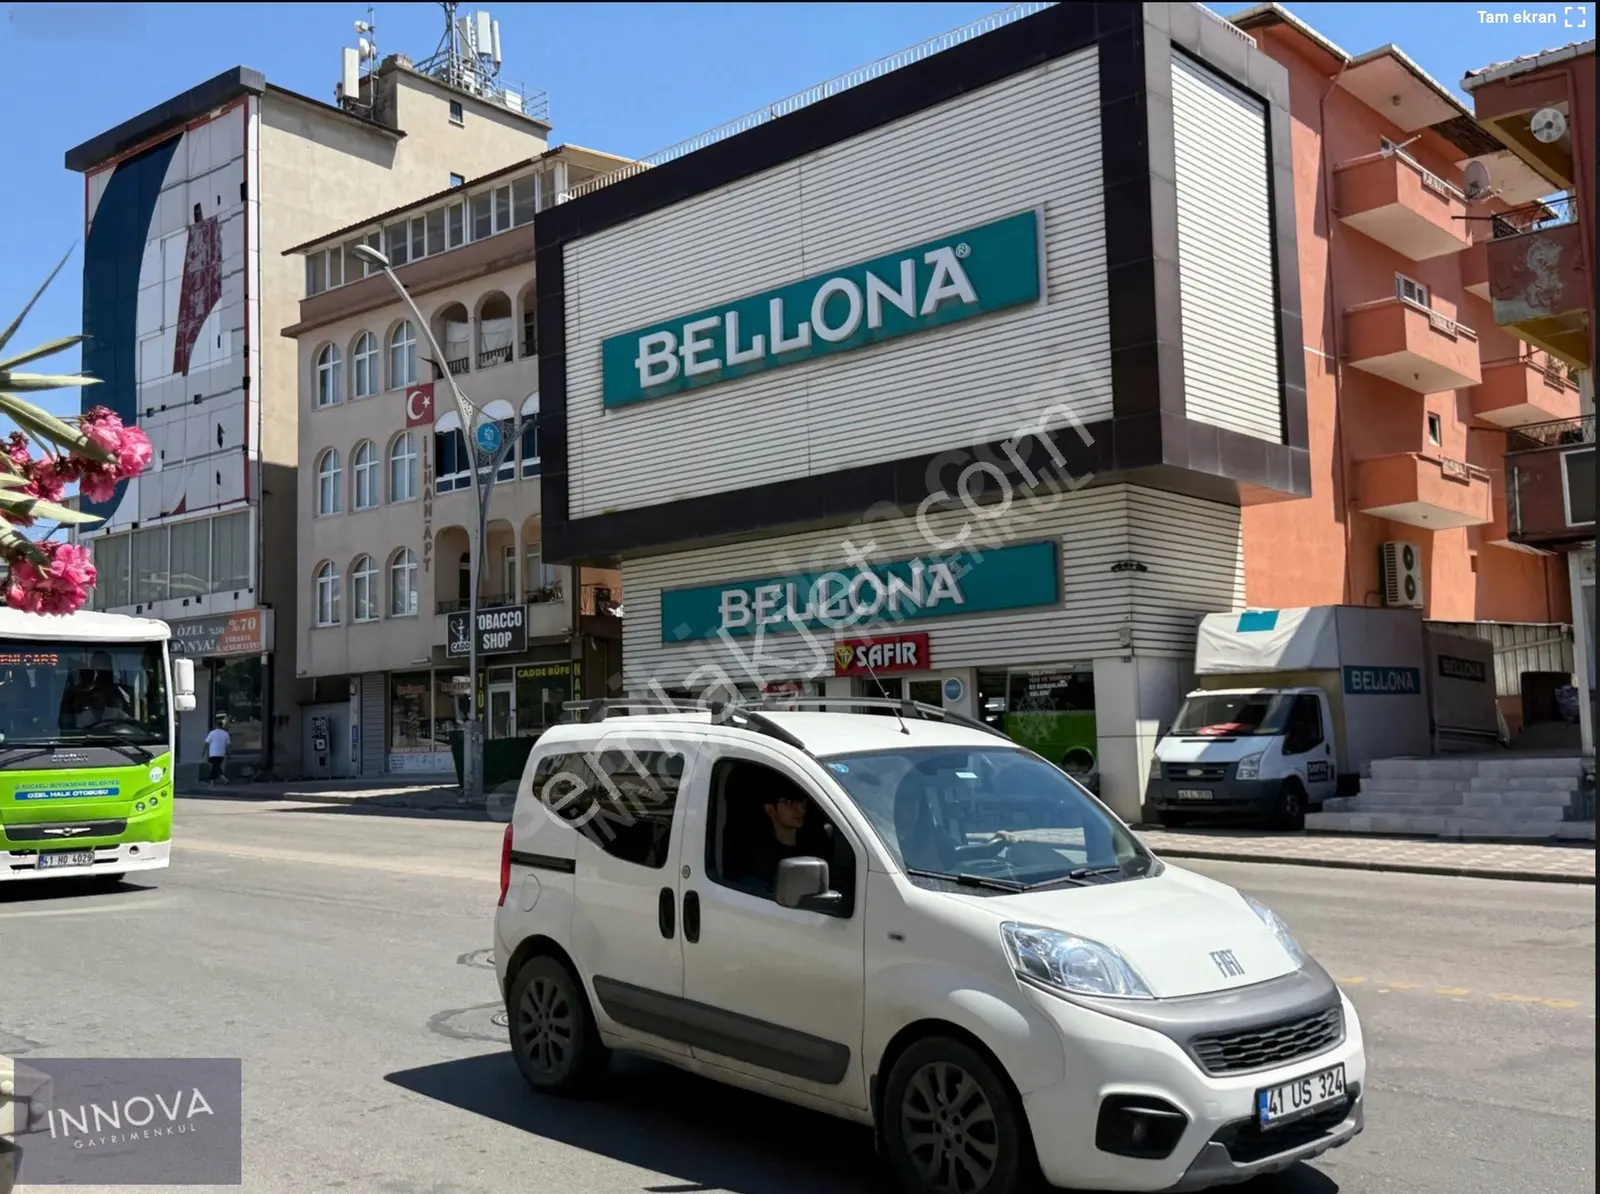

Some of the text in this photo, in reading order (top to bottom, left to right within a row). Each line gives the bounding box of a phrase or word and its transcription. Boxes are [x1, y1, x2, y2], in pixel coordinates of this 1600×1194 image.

[477, 610, 522, 631] OBACCO
[451, 642, 471, 651] CADD
[482, 631, 512, 650] SHOP
[517, 665, 570, 678] CADDE BÜFE
[1443, 658, 1482, 678] BELLONA
[1351, 670, 1415, 691] BELLONA
[43, 855, 53, 865] 41
[1208, 948, 1245, 978] FIAT
[1268, 1068, 1343, 1115] 41 US 324
